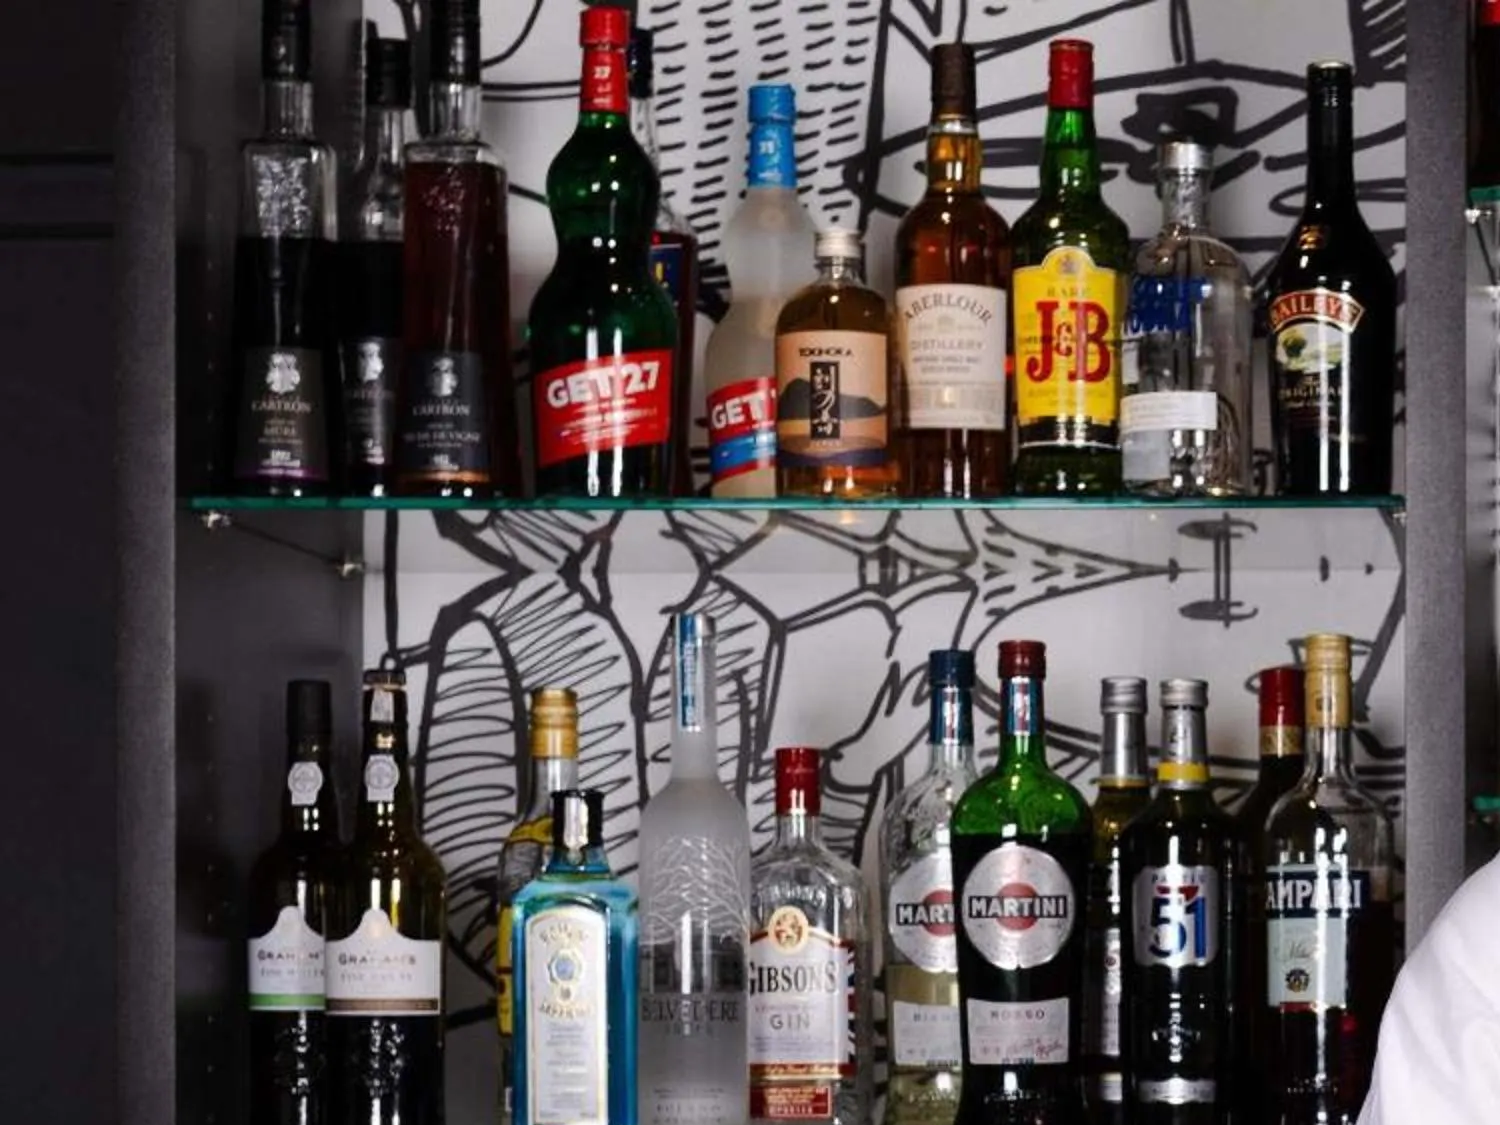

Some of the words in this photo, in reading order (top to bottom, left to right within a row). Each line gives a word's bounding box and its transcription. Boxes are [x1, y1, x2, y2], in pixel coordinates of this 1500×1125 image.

[905, 293, 992, 328] ABERLOUR
[1026, 301, 1111, 382] J&B
[547, 366, 615, 408] GET
[620, 361, 660, 395] 27
[711, 391, 764, 430] GET
[971, 896, 1065, 918] MARTINI
[1265, 879, 1362, 910] AMPARI
[899, 905, 954, 924] MART
[1149, 896, 1206, 959] 51
[770, 1014, 810, 1030] GIN
